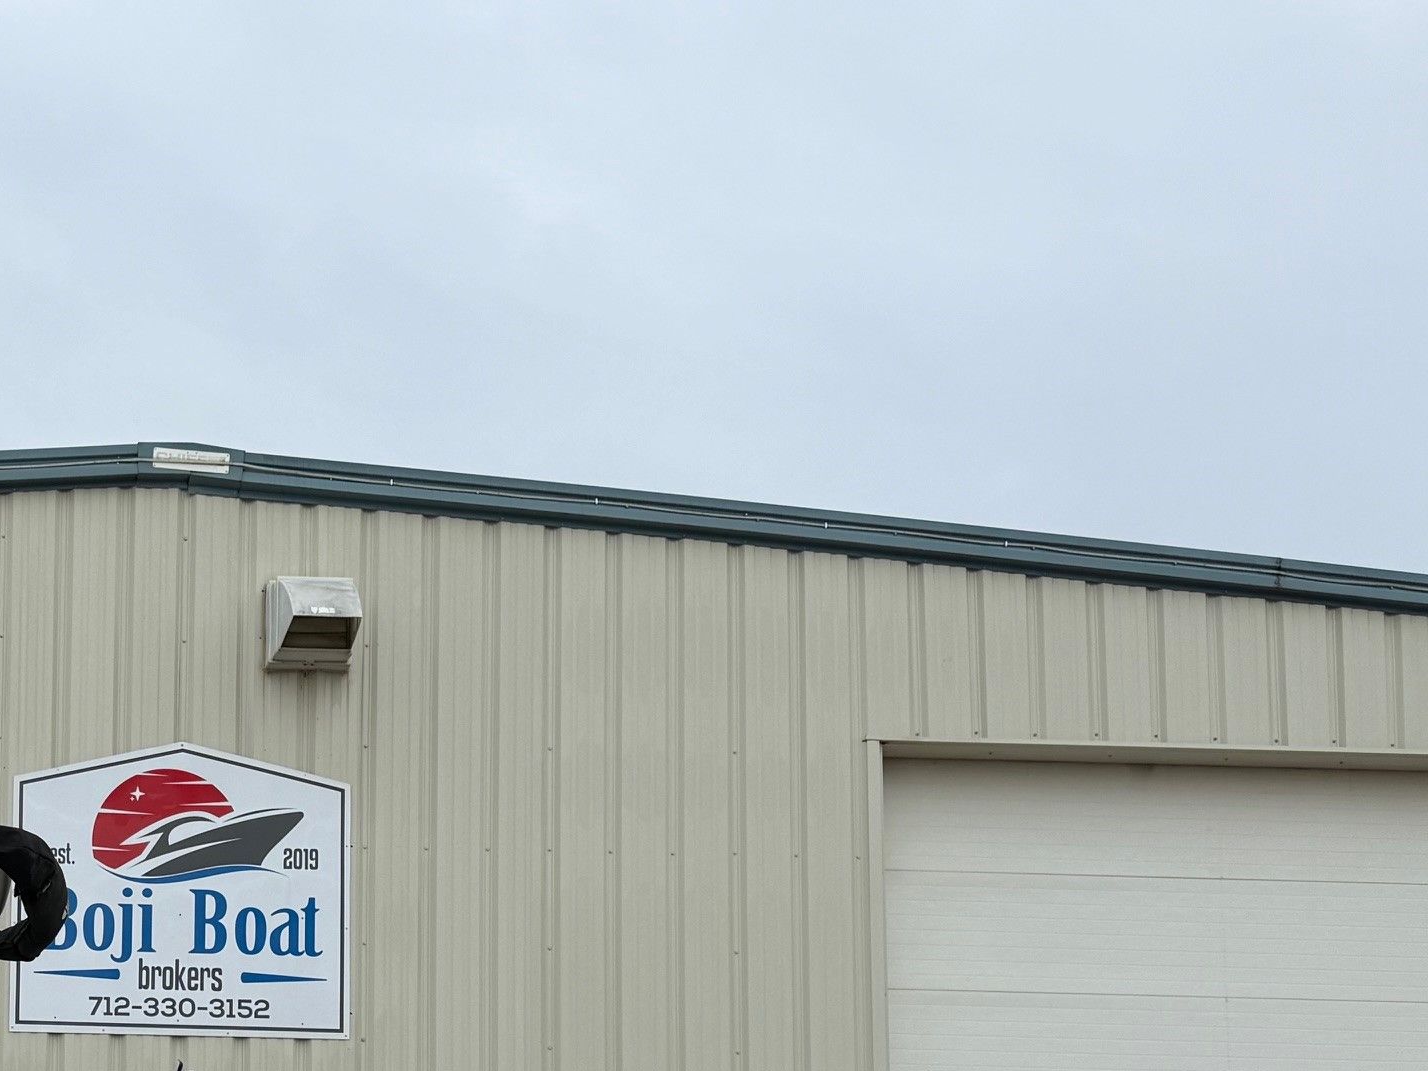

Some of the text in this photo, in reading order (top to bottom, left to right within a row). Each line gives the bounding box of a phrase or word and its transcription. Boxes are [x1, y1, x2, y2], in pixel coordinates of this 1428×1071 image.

[50, 842, 319, 870] est. 2019
[44, 887, 323, 963] Boji Boat
[138, 958, 223, 991] brokers
[88, 996, 270, 1019] 712-330-3152
